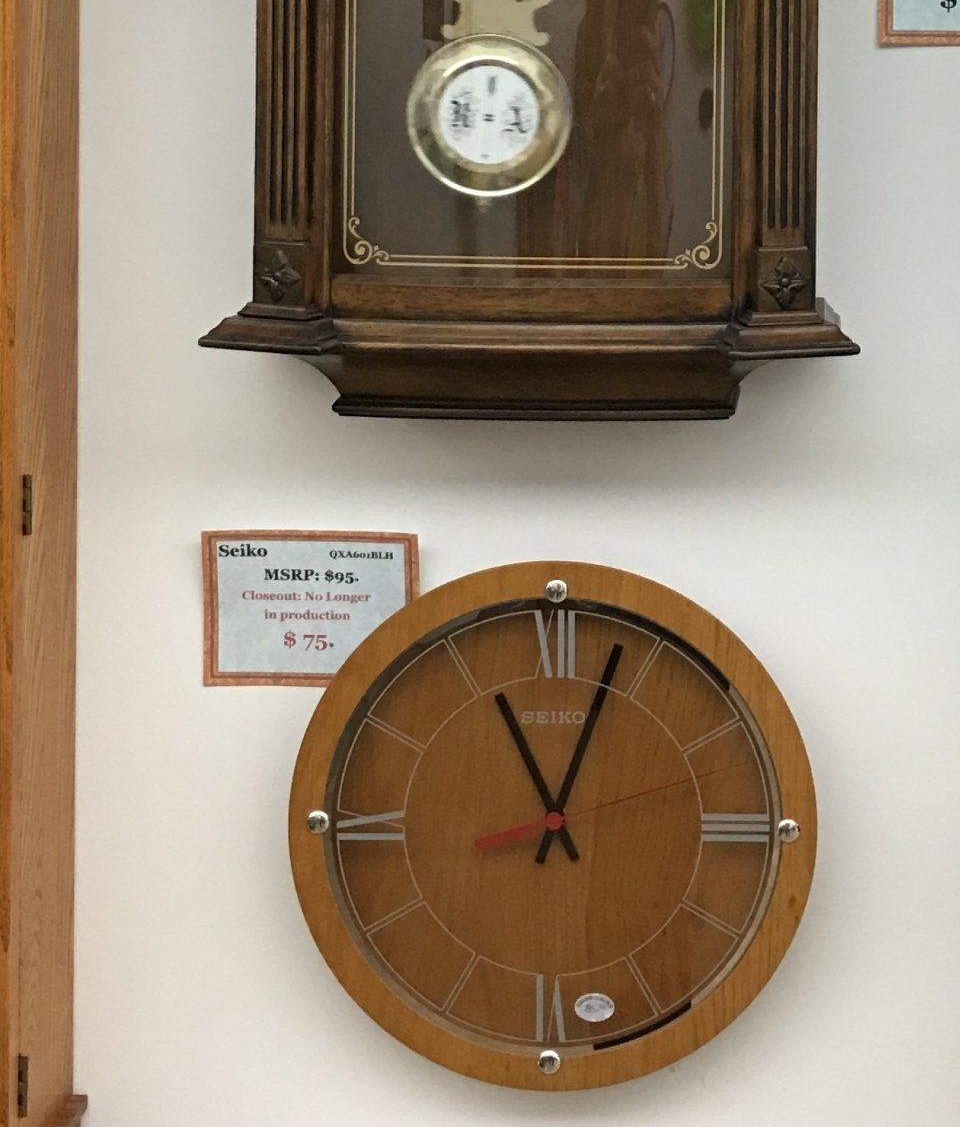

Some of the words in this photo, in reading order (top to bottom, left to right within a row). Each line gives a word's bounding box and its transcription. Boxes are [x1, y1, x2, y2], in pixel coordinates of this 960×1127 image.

[218, 543, 268, 558] Seiko
[329, 549, 394, 560] QXA601BLH
[264, 568, 320, 582] MSRP:
[324, 568, 359, 585] $95.
[241, 590, 302, 602] Closeout:
[305, 591, 323, 602] No
[325, 591, 371, 603] Longer
[264, 609, 277, 620] in
[280, 609, 351, 622] production
[521, 710, 586, 724] SEIKO
